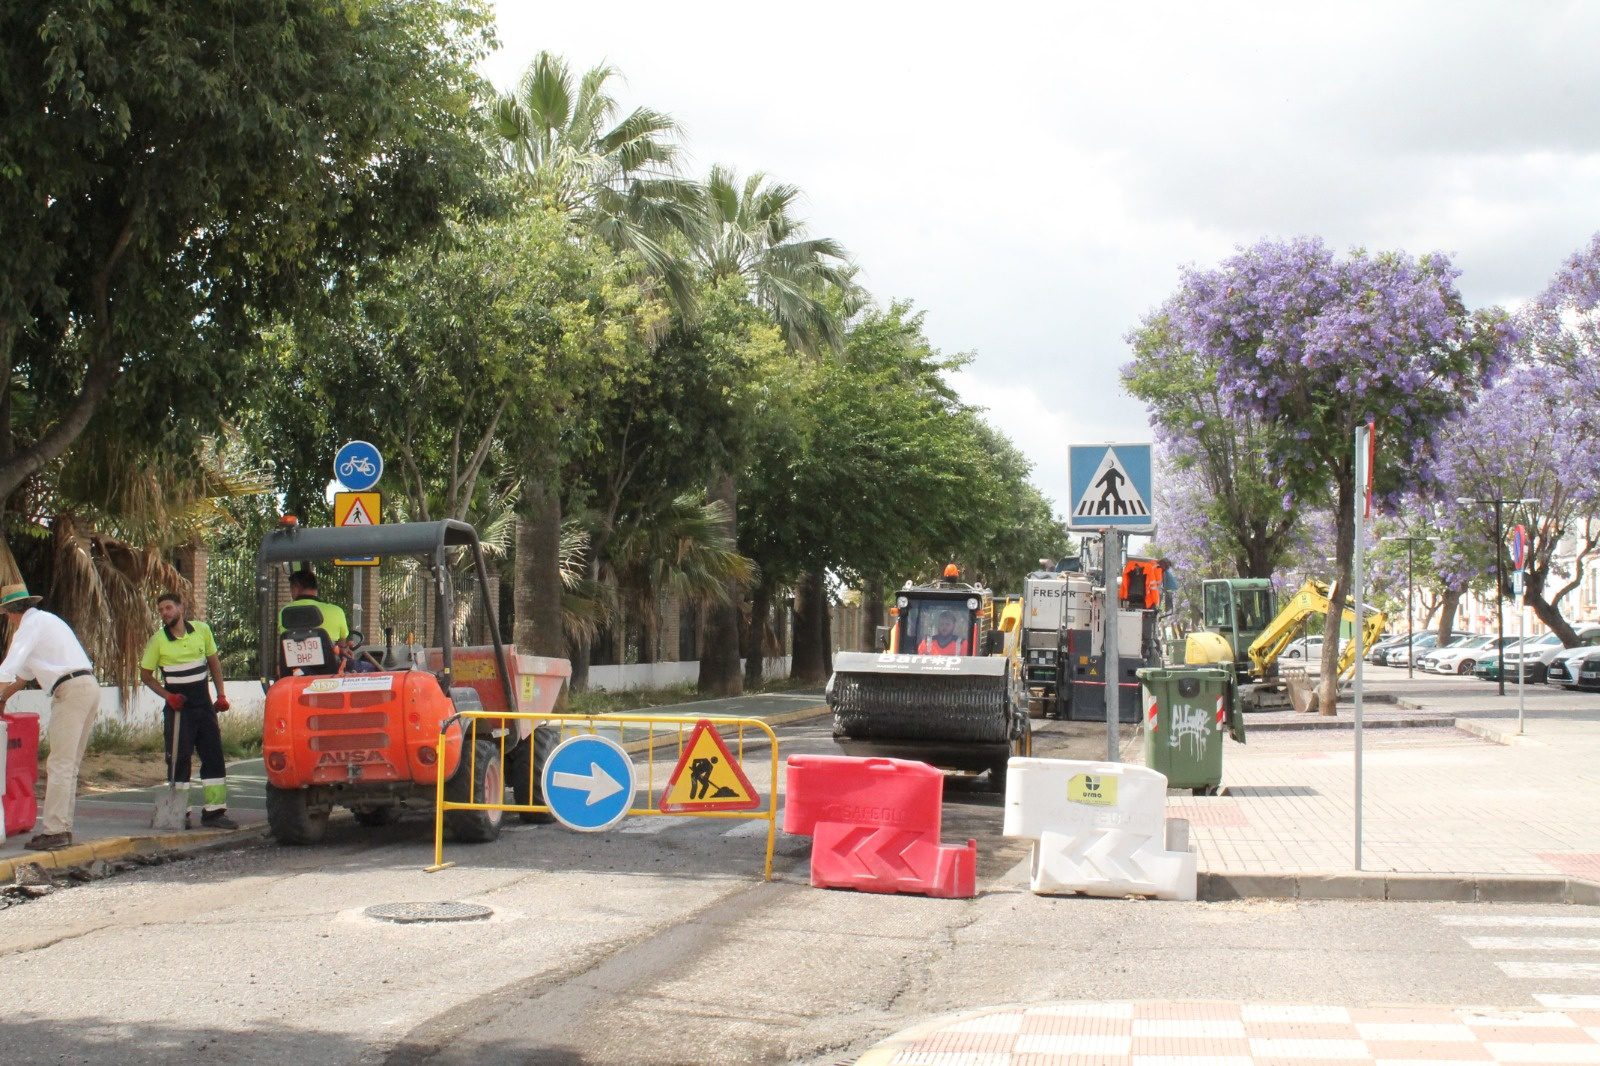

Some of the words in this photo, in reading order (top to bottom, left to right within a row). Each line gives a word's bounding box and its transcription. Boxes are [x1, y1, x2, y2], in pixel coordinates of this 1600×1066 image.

[1033, 589, 1076, 598] FRESAR
[287, 642, 292, 651] E
[296, 640, 318, 651] 5130
[319, 751, 385, 763] AUSA
